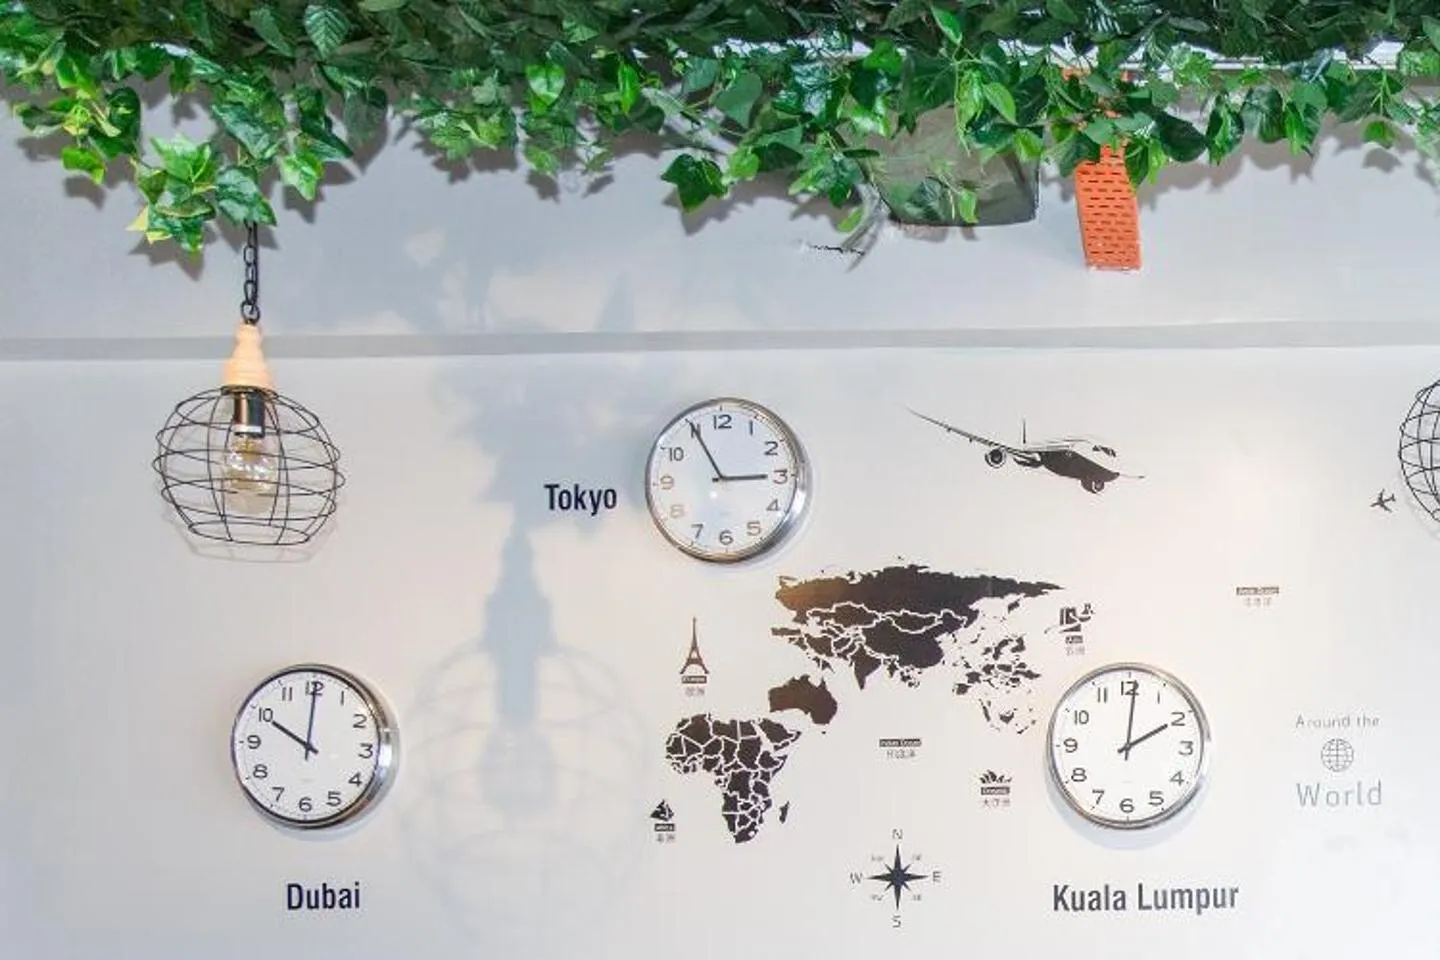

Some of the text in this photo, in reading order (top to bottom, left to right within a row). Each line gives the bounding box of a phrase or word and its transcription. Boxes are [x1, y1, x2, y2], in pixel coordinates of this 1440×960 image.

[713, 415, 732, 430] 12
[749, 421, 754, 435] 1
[669, 447, 684, 461] 10
[764, 441, 779, 455] 2
[660, 476, 674, 490] 9
[774, 469, 787, 484] 3
[543, 483, 617, 517] Tokyo
[766, 499, 779, 512] 4
[670, 505, 685, 518] 8
[692, 524, 703, 538] 7
[747, 521, 761, 536] 5
[719, 530, 734, 545] 6
[282, 687, 293, 701] 11
[305, 681, 324, 696] 12
[1098, 687, 1107, 704] 11
[1121, 680, 1139, 696] 12
[340, 690, 345, 706] 1
[1156, 692, 1161, 704] 1
[259, 708, 273, 722] 10
[353, 714, 367, 728] 2
[1074, 710, 1089, 725] 10
[1171, 712, 1185, 726] 2
[1296, 714, 1381, 728] Around the
[247, 735, 261, 750] 9
[1064, 738, 1078, 753] 9
[1178, 741, 1193, 756] 3
[359, 743, 373, 758] 3
[253, 764, 268, 778] 8
[1071, 768, 1087, 782] 8
[1170, 771, 1185, 786] 4
[349, 772, 363, 787] 4
[272, 787, 284, 802] 7
[326, 791, 341, 807] 5
[1092, 789, 1105, 804] 7
[1148, 791, 1164, 805] 5
[1296, 779, 1382, 807] World
[299, 797, 312, 812] 6
[1119, 798, 1134, 813] 6
[287, 881, 360, 910] Dubai
[1053, 882, 1239, 915] Kuala Lumpur
